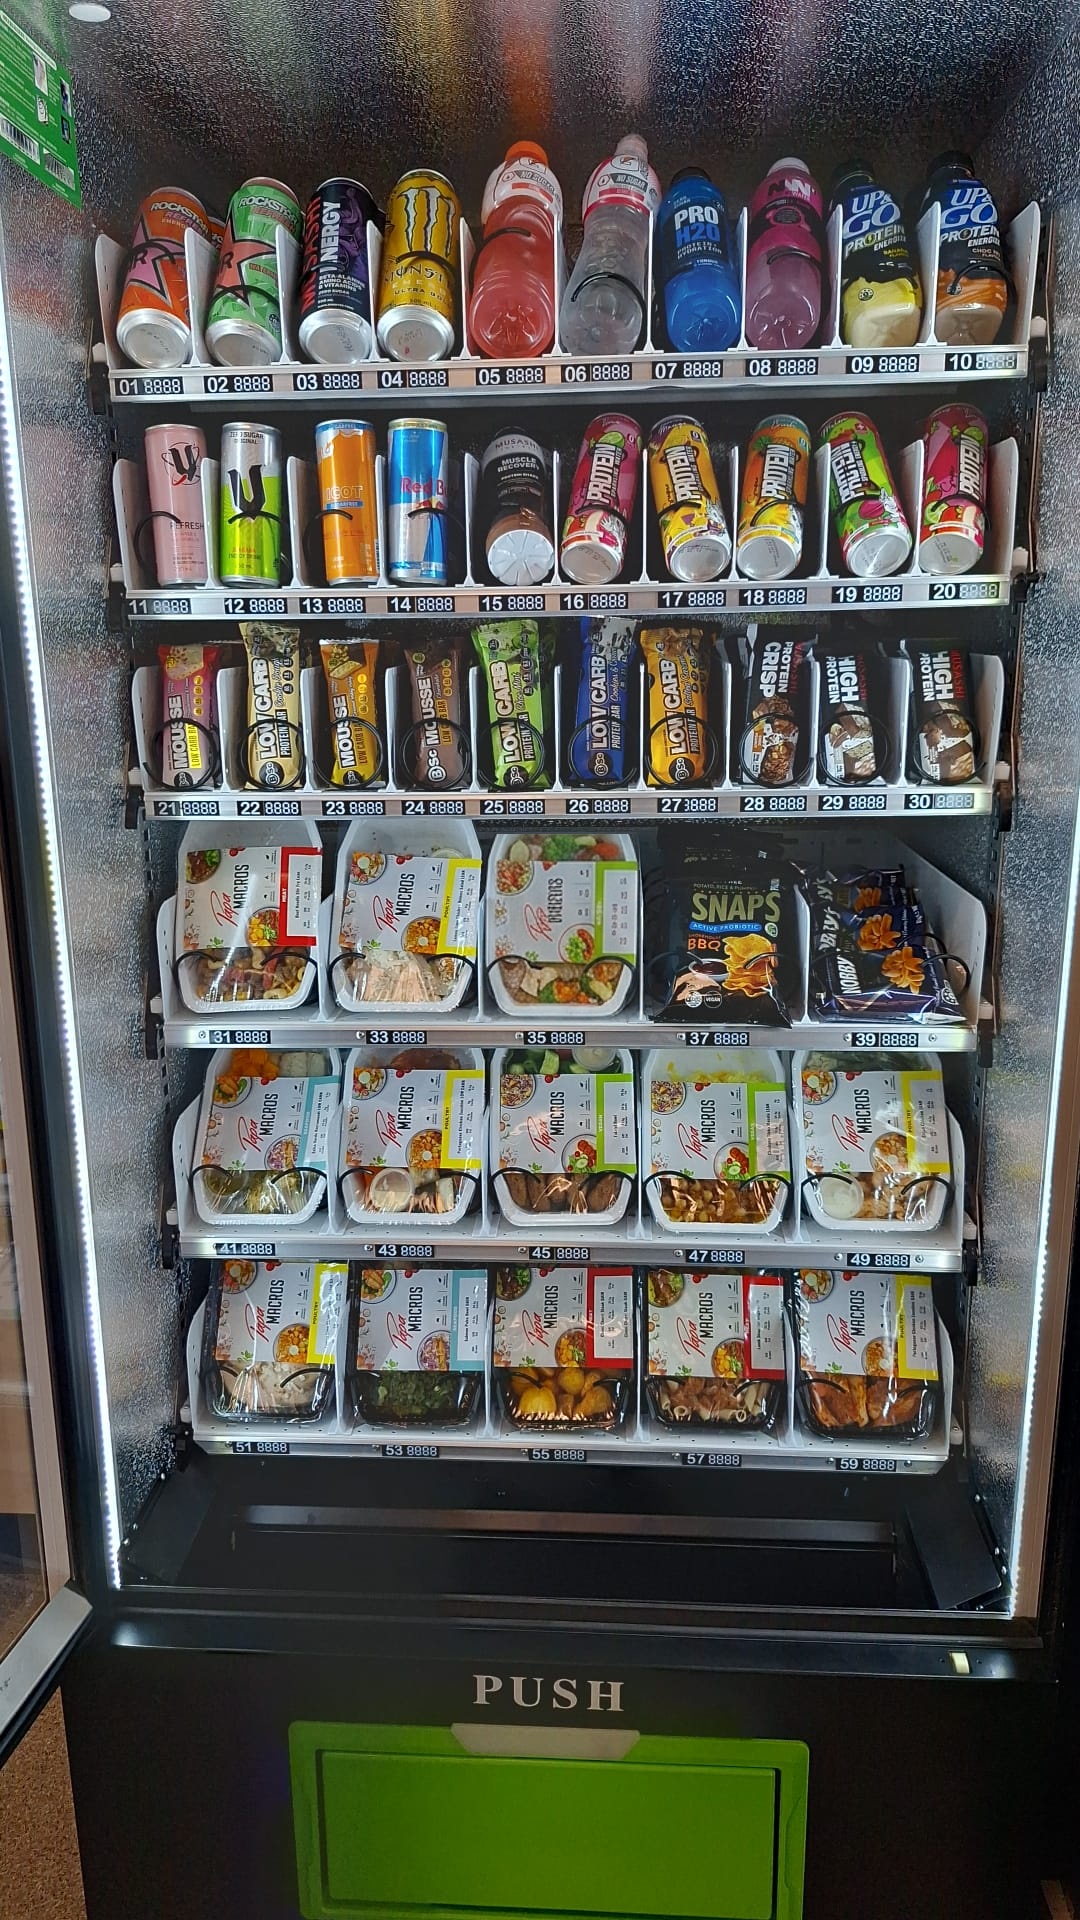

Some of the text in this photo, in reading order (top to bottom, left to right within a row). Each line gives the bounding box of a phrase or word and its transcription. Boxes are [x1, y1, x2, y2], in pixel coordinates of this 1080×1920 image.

[626, 175, 646, 188] SUGAR
[238, 196, 298, 224] ROCKSTAR
[674, 205, 719, 231] PRO
[940, 200, 998, 229] GO
[842, 202, 901, 239] GO
[845, 224, 905, 259] PROTEIN
[939, 225, 1001, 247] PROTEIN
[654, 362, 721, 379] 07 8888
[749, 358, 816, 376] 08 8888
[851, 356, 918, 373] 09 8888
[950, 354, 973, 370] 10
[296, 374, 360, 390] 03 8888
[381, 370, 446, 388] 04 8888
[478, 369, 500, 385] 05
[564, 365, 630, 382] 06 8888
[119, 378, 180, 394] 01 8888
[207, 376, 270, 392] 02 8888
[497, 462, 540, 473] RECOVERY
[501, 456, 537, 466] MUSCLE
[959, 434, 984, 499] PROTEIN
[586, 443, 621, 505] PROTEIN
[665, 446, 702, 503] PROTEIN
[761, 444, 790, 499] PROTEIN
[402, 477, 433, 495] Red
[662, 592, 683, 606] 17
[743, 589, 806, 605] 18 8888
[836, 586, 900, 602] 19 8888
[933, 584, 956, 600] 20
[128, 599, 148, 614] 11
[224, 598, 245, 614] 12
[302, 598, 364, 613] 13 8888
[390, 596, 453, 612] 14 8888
[482, 596, 544, 612] 15 8888
[563, 594, 627, 610] 16 8888
[760, 642, 782, 698] CRISP
[778, 642, 794, 693] PROTEIN
[932, 651, 954, 700] HIGH
[252, 657, 273, 712] CARB
[590, 655, 609, 705] CARB
[825, 656, 841, 704] PROTEIN
[838, 656, 860, 702] HIGH
[920, 652, 935, 702] PROTEIN
[489, 660, 522, 764] LOW CARB
[659, 658, 688, 756] LOW CARB
[168, 695, 189, 769] MOUSSE
[332, 694, 357, 768] MOUSSE
[188, 733, 201, 768] LOW CARB
[277, 727, 292, 757] PROTEIN
[355, 730, 368, 764] LOW CARB
[520, 727, 535, 761] PROTEIN
[158, 802, 218, 815] 21 8888
[240, 802, 300, 815] 22 8888
[326, 802, 346, 815] 23
[405, 801, 464, 814] 24 8888
[484, 800, 544, 814] 25 8888
[568, 799, 628, 813] 26 8888
[661, 798, 682, 812] 27
[744, 796, 805, 811] 28 8888
[822, 796, 843, 810] 29
[908, 794, 930, 808] 30
[233, 864, 249, 910] MACROS
[396, 873, 416, 916] MACROS
[692, 891, 780, 922] SNAPS
[693, 923, 760, 932] ACTIVE PROBIOTIC
[688, 938, 721, 952] BBQ
[214, 1031, 268, 1043] 31 8888
[370, 1031, 426, 1044] 33 8888
[527, 1032, 584, 1044] 35 8888
[690, 1032, 748, 1045] 37 8888
[856, 1033, 877, 1046] 39
[260, 1093, 278, 1136] MACROS
[397, 1086, 415, 1130] MACROS
[550, 1091, 565, 1136] MACROS
[854, 1088, 872, 1134] MACROS
[701, 1099, 716, 1143] MACROS
[220, 1244, 240, 1255] 41
[378, 1244, 432, 1257] 43 8888
[532, 1246, 589, 1260] 45 8888
[688, 1250, 744, 1262] 47 8888
[850, 1254, 909, 1266] 49 8888
[266, 1279, 284, 1324] MACROS
[408, 1286, 424, 1332] MACROS
[544, 1285, 558, 1329] MACROS
[699, 1292, 714, 1339] MACROS
[850, 1290, 866, 1337] MACROS
[236, 1442, 252, 1452] 51
[385, 1446, 437, 1457] 53 8888
[532, 1449, 584, 1460] 55 8888
[687, 1453, 740, 1466] 57 8888
[840, 1458, 895, 1471] 59 8888
[472, 1674, 625, 1712] PUSH
